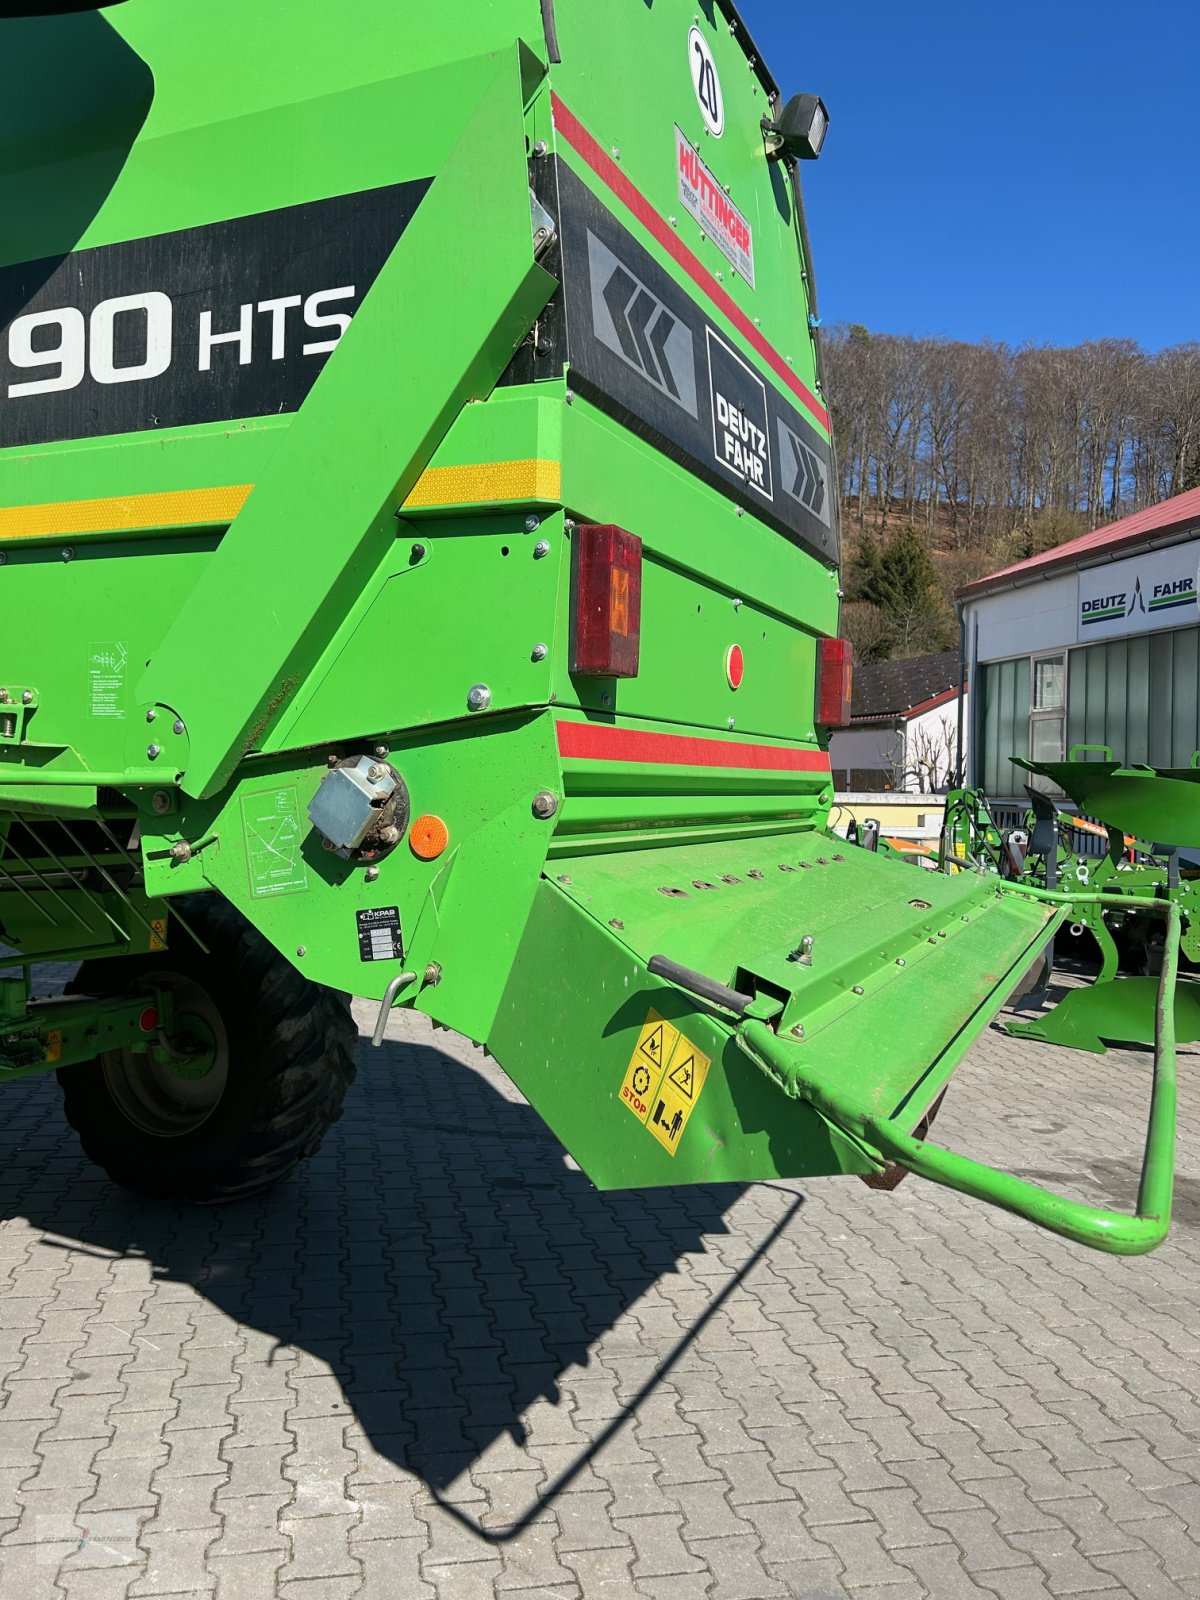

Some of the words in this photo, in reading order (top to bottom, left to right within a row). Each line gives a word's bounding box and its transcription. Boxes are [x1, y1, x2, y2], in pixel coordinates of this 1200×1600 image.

[694, 41, 718, 123] 20
[8, 291, 172, 398] 90
[198, 285, 355, 371] HTS
[716, 391, 767, 460] DEUTZ
[724, 431, 764, 487] FAHR
[1081, 593, 1127, 613] DEUTZ
[1153, 577, 1194, 598] FAHR
[622, 1086, 647, 1114] STOP
